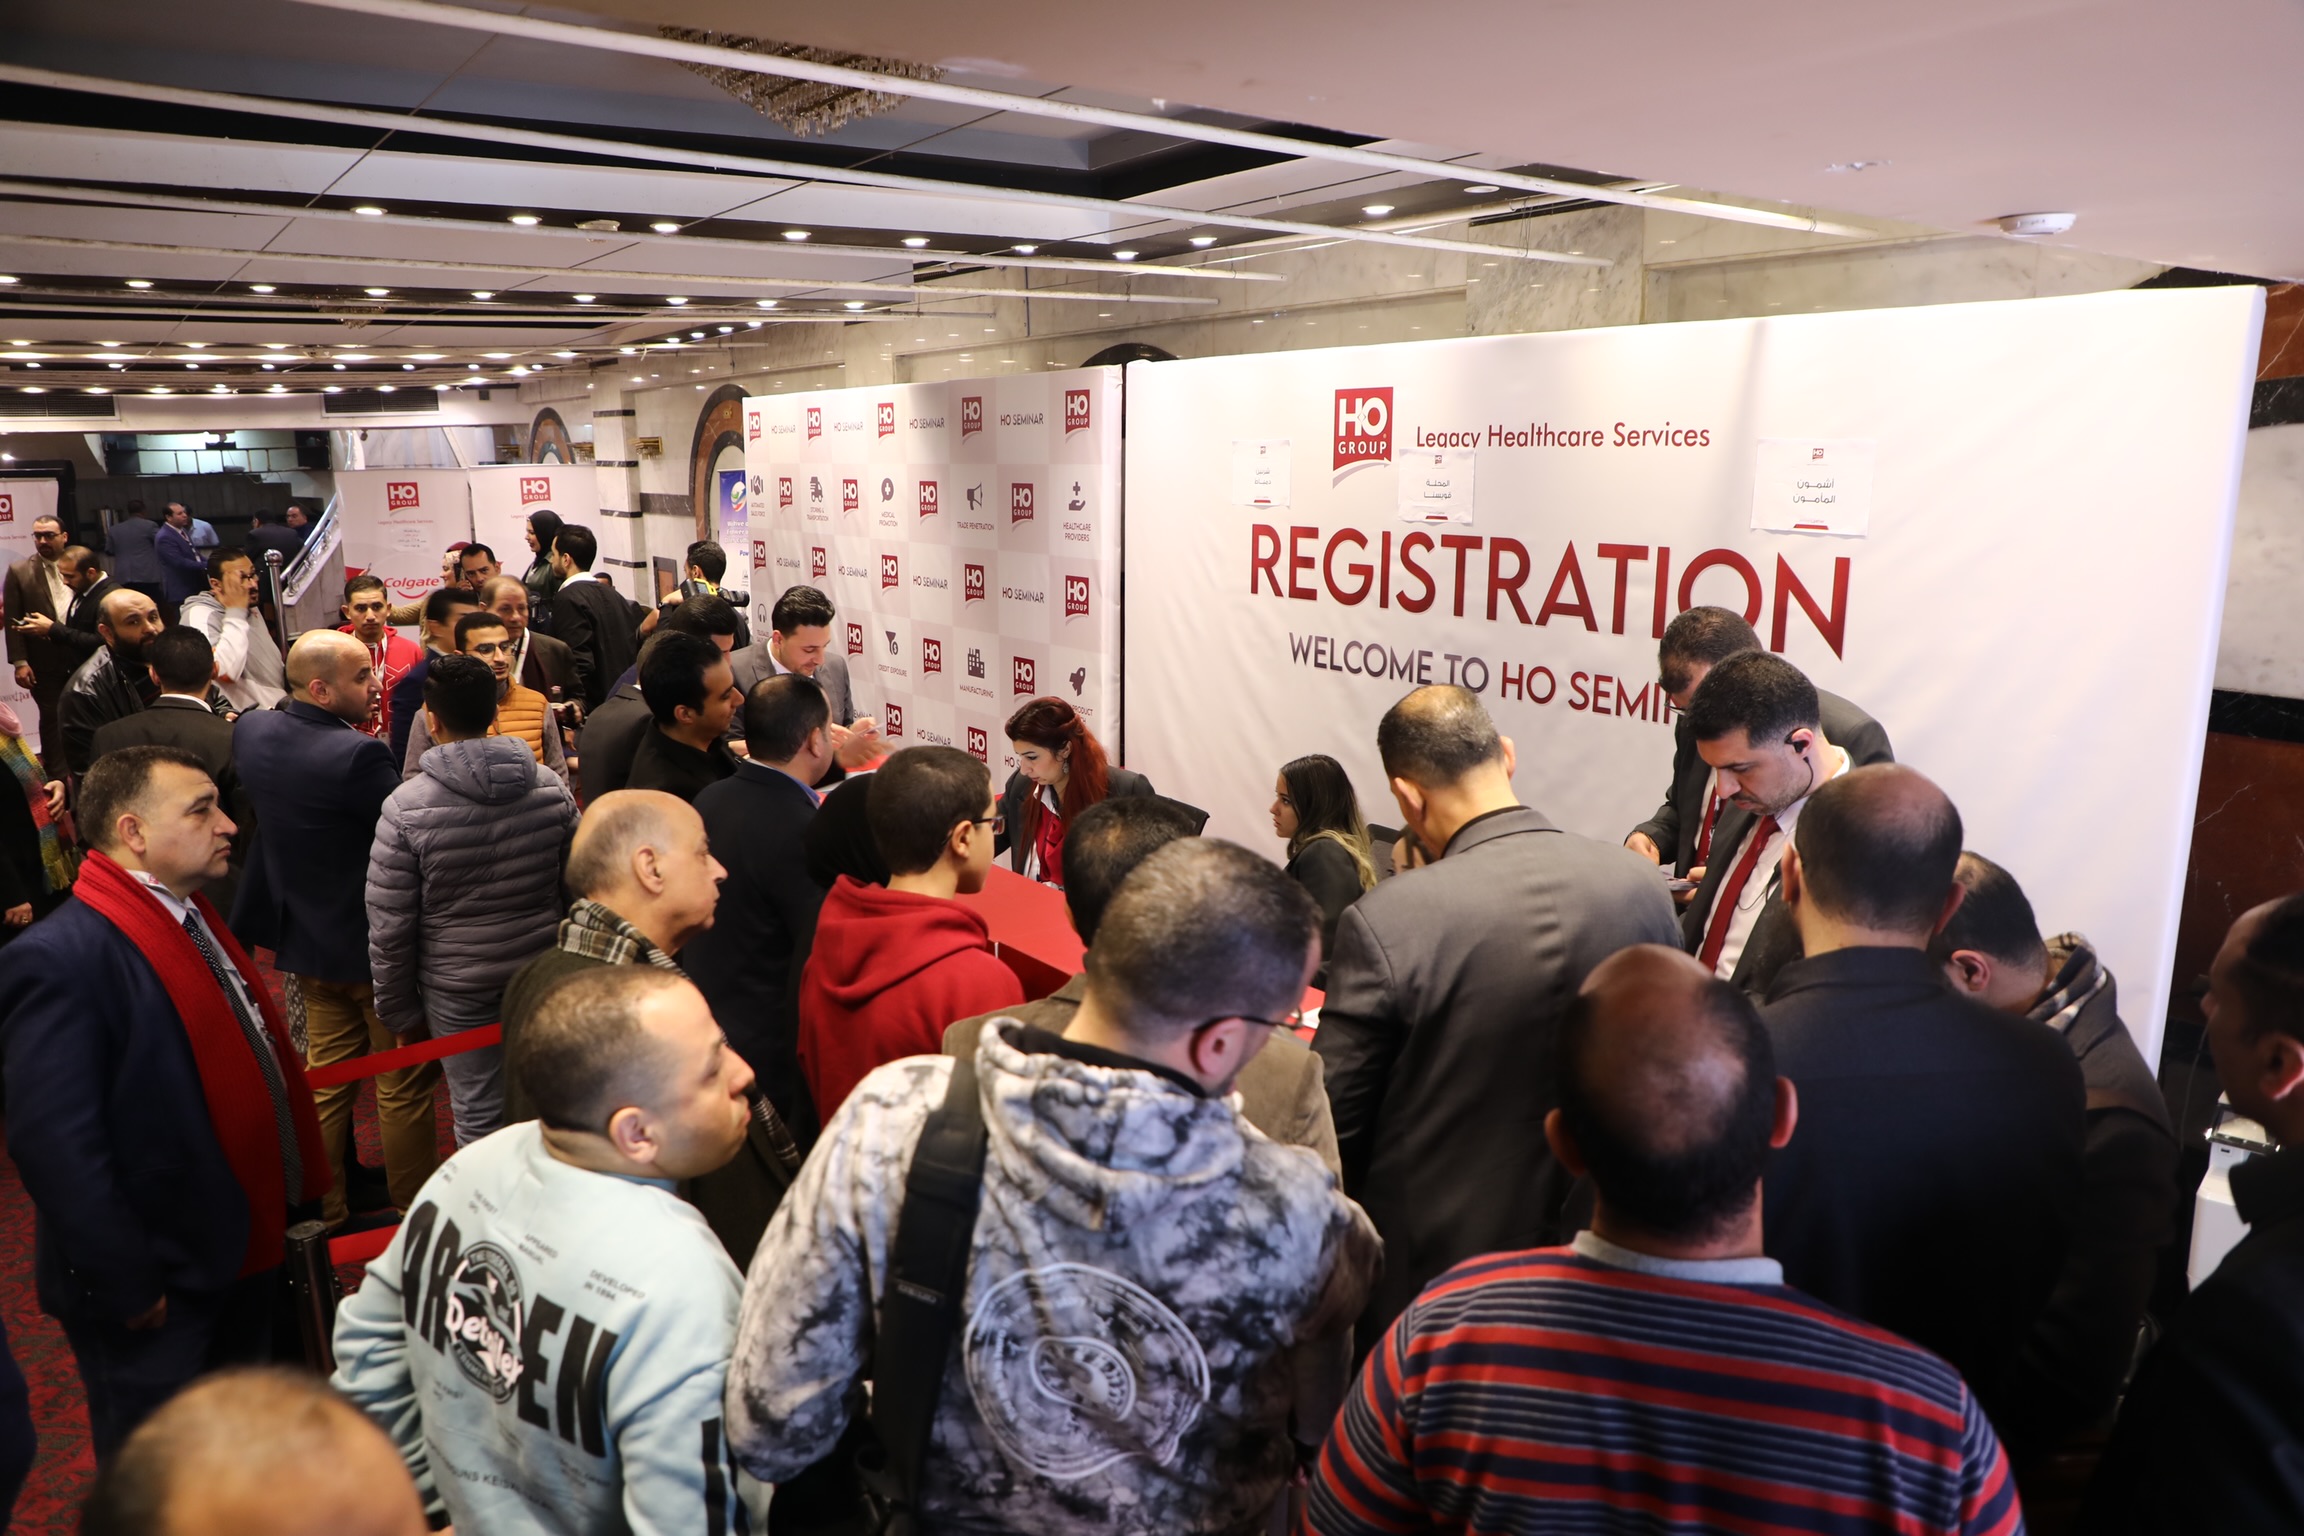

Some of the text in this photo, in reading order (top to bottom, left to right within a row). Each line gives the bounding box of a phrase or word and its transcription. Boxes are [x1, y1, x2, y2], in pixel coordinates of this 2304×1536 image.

[964, 401, 981, 420] HO
[1067, 395, 1088, 416] HO
[749, 415, 760, 430] HO
[808, 411, 820, 427] HO
[879, 406, 893, 424] HO
[1000, 413, 1044, 426] HO SEMINAR
[1067, 417, 1088, 426] GROUP
[1338, 397, 1388, 437] HO
[834, 421, 863, 432] HO SEMINAR
[909, 417, 945, 429] HO SEMINAR
[1416, 421, 1710, 448] Legacy Healthcare Services
[1338, 441, 1387, 454] GROUP
[390, 484, 415, 499] HO
[523, 479, 548, 494] HO
[780, 480, 791, 496] HO
[844, 483, 857, 499] HO
[921, 484, 936, 503] HO
[0, 498, 10, 512] O
[1013, 488, 1031, 507] HO
[1793, 493, 1836, 504] المأمون
[957, 521, 994, 531] TRADE PENETRATION
[1063, 522, 1091, 531] HEALTHCARE
[1065, 533, 1090, 542] PROVIDERS
[754, 544, 765, 558] HO
[813, 550, 825, 566] HO
[776, 557, 800, 568] HO SEMINAR
[883, 558, 897, 576] HO
[838, 566, 868, 578] HO SEMINAR
[966, 568, 983, 587] HO
[384, 577, 439, 589] Colgate
[883, 576, 898, 584] GROUP
[913, 575, 948, 589] HO SEMINAR
[966, 588, 984, 596] GROUP
[1002, 587, 1045, 604] HO SEMINAR
[1067, 580, 1087, 602] HO
[1250, 524, 1851, 662] REGISTRATION
[1067, 602, 1088, 612] GROUP
[848, 626, 861, 643] HO
[924, 642, 940, 660] HO
[878, 664, 907, 677] CREDIT EXPOSURE
[924, 660, 940, 669] GROUP
[1015, 661, 1033, 682] HO
[1015, 681, 1034, 691] GROUP
[1289, 632, 1680, 725] WELCOME TO HO SEMI
[959, 684, 994, 699] MANUFACTURING
[887, 707, 900, 725] HO
[1072, 705, 1093, 716] PRODUCT
[888, 724, 902, 733] GROUP
[917, 728, 952, 745] HO SEMINAR
[969, 731, 985, 751] HO
[969, 750, 986, 760] GROUP
[1005, 755, 1014, 768] HO
[590, 1269, 646, 1299] DEVELOPED
